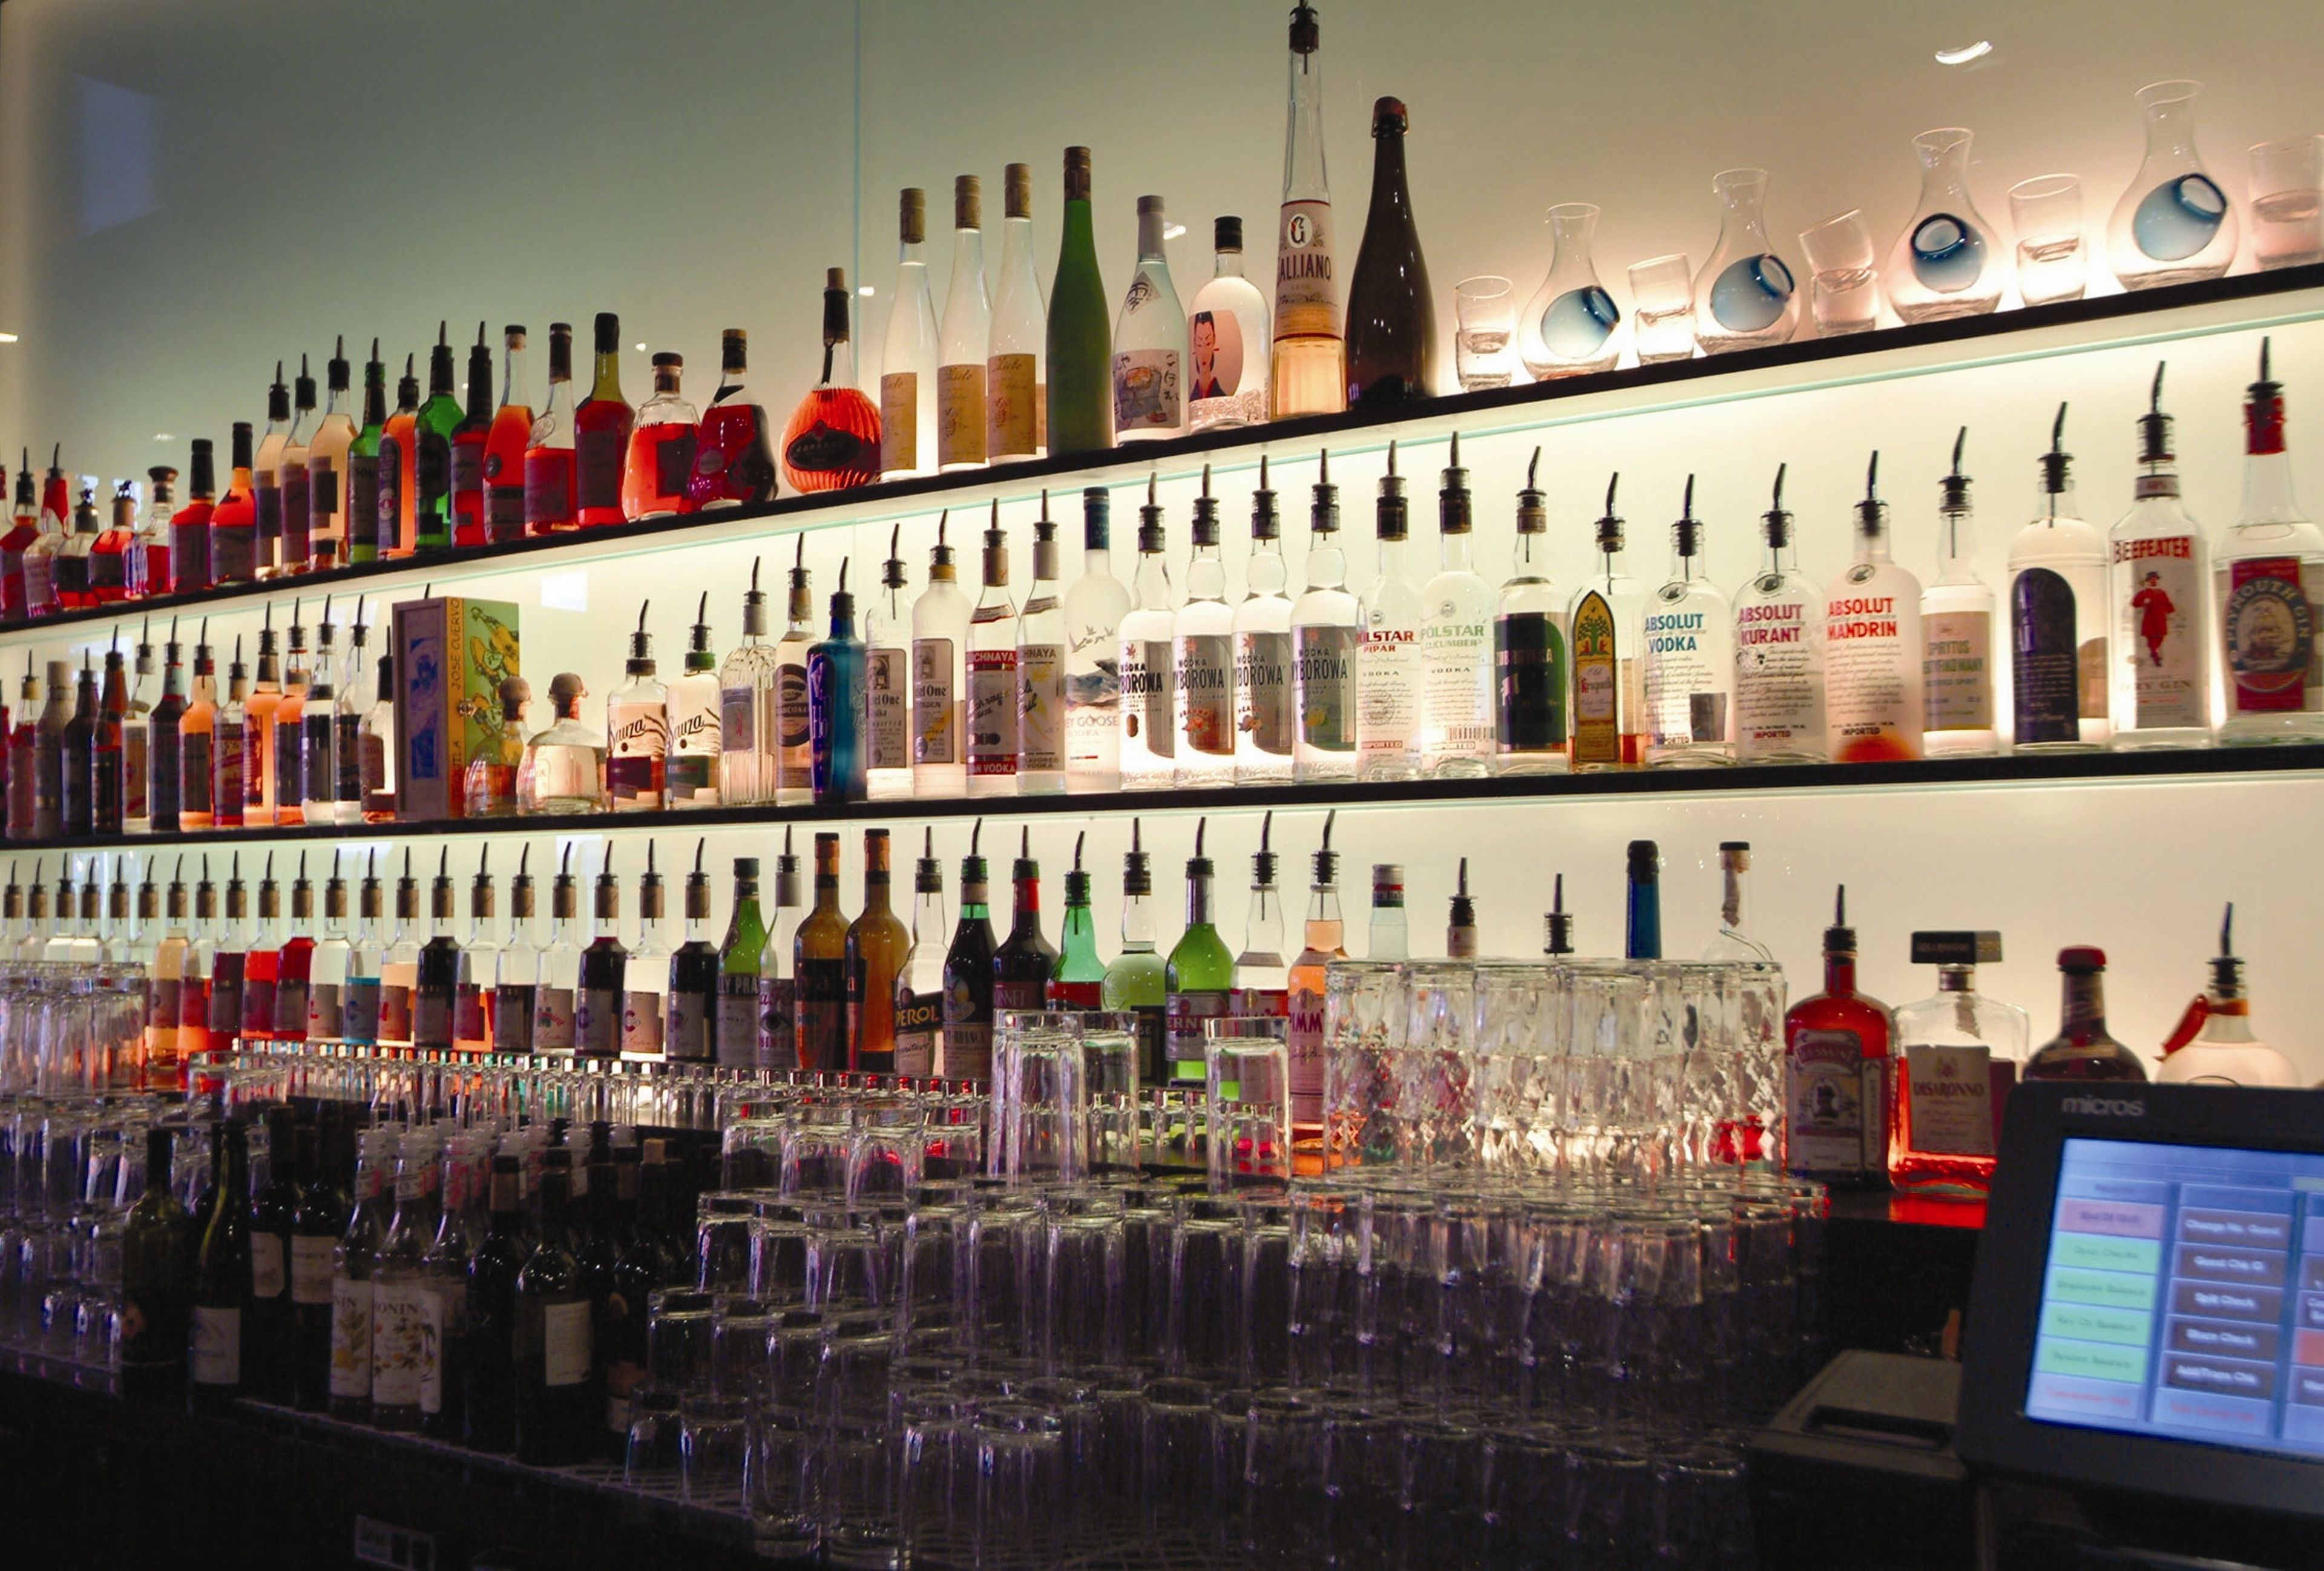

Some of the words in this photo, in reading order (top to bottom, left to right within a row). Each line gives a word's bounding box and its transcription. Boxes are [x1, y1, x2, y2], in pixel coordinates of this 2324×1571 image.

[2113, 538, 2191, 564] BEEFEATER
[1739, 604, 1802, 624] ABSOLUT
[1828, 597, 1894, 617] ABSOLUT
[450, 598, 461, 650] CUERVO
[1644, 613, 1704, 632] ABSOLUT
[2295, 605, 2309, 637] GIN
[1422, 625, 1484, 639] POLSTAR
[1741, 627, 1801, 646] KURANT
[1827, 621, 1897, 641] MANDRIN
[1363, 645, 1396, 653] PIPAR
[1649, 636, 1697, 654] VODKA
[451, 654, 461, 690] JOSE
[927, 683, 948, 697] One
[2159, 679, 2192, 690] GIN
[882, 694, 900, 705] One
[1077, 714, 1119, 728] GOOSE
[608, 719, 646, 751] Sauza
[668, 715, 704, 751] Sauza
[1753, 730, 1791, 739] IMPORTED
[983, 762, 1016, 773] VODKA
[1912, 1081, 1984, 1097] DISARONNO
[2062, 1095, 2145, 1116] micros
